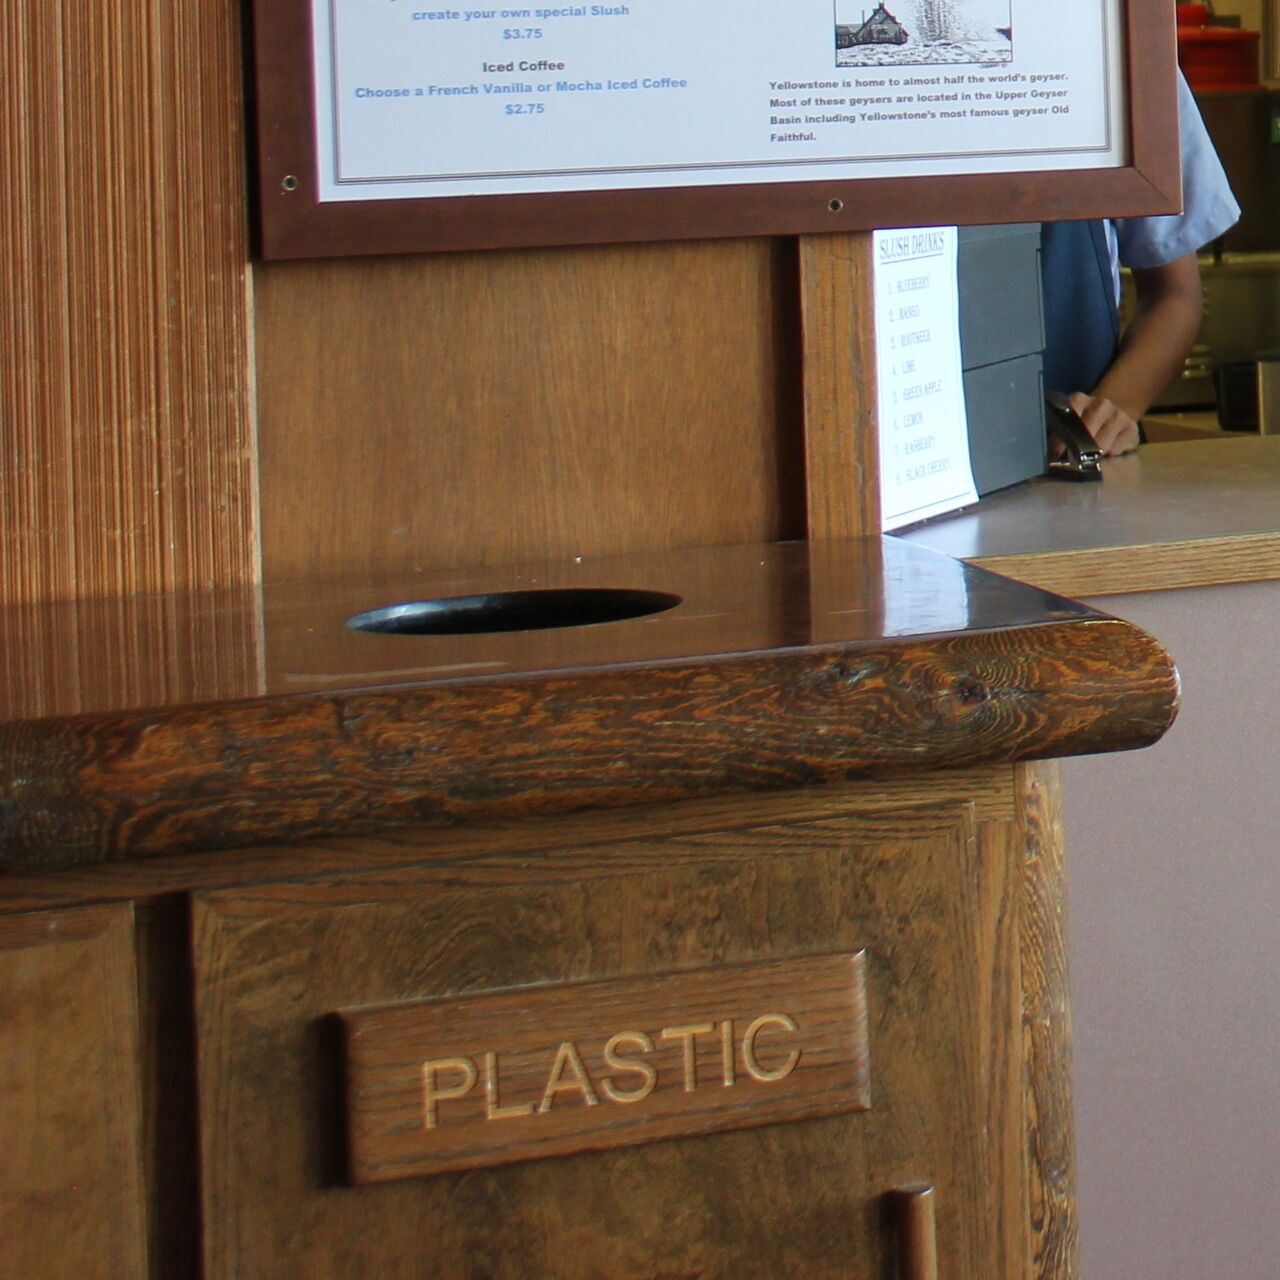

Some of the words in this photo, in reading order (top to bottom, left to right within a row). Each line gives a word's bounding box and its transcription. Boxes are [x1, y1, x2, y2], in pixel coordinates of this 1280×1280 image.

[502, 28, 542, 40] $3.75
[483, 62, 514, 72] Iced
[519, 60, 564, 71] Coffee
[770, 99, 796, 108] Most
[800, 98, 812, 106] of
[815, 98, 845, 106] these
[849, 97, 892, 107] geysers
[917, 93, 958, 102] located
[962, 92, 971, 100] in
[975, 92, 992, 100] the
[996, 91, 1027, 100] Upper
[1031, 90, 1067, 99] Geyser
[770, 132, 816, 142] Faithful.
[879, 237, 910, 260] SLUSH
[912, 231, 945, 255] DRINKS
[422, 1012, 803, 1130] PLASTIC
